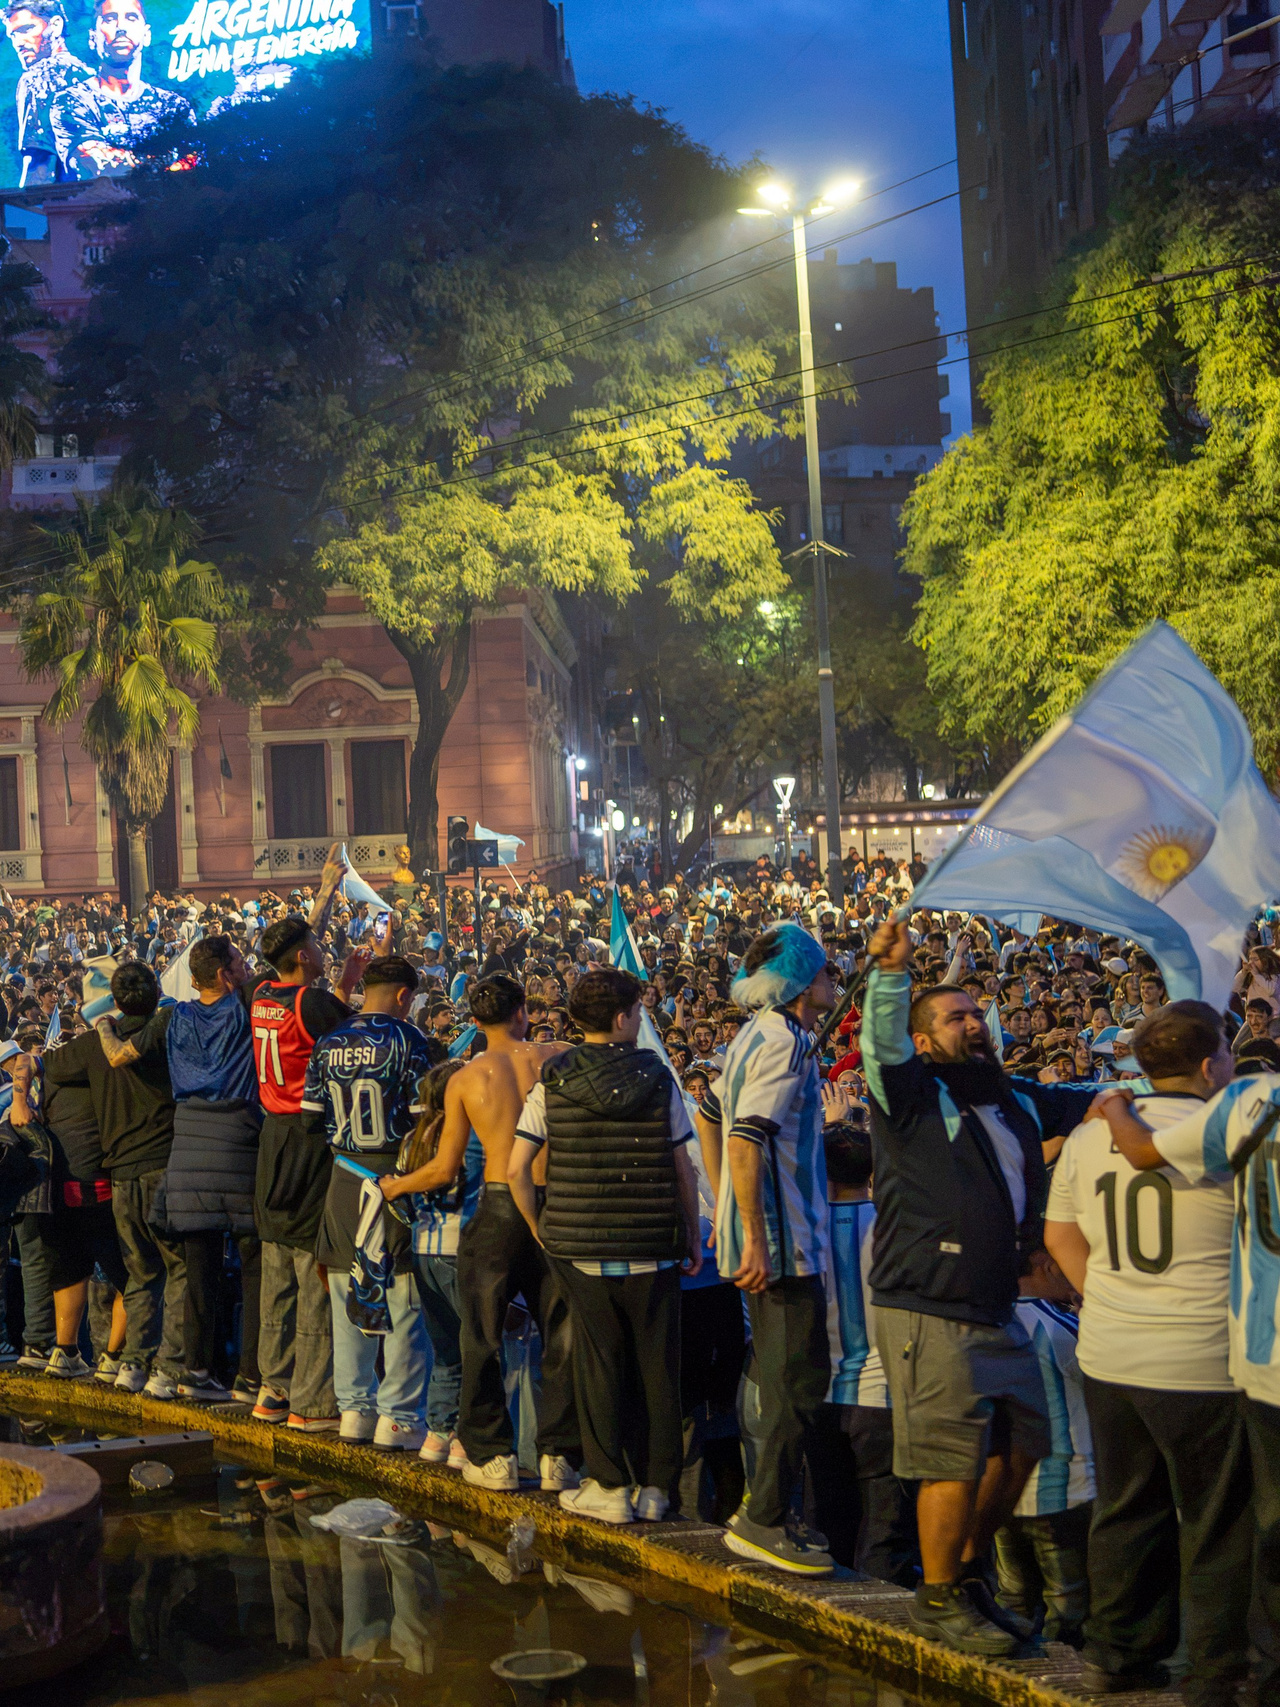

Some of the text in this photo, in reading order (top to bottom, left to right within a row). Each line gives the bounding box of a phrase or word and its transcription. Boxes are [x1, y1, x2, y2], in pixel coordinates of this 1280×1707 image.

[233, 38, 258, 65] DE
[236, 71, 291, 92] YPF
[252, 1005, 285, 1021] JUAN CRUZ
[255, 1026, 285, 1086] 71
[329, 1047, 376, 1066] MESSI
[327, 1078, 386, 1149] 10
[1095, 1171, 1173, 1274] 10
